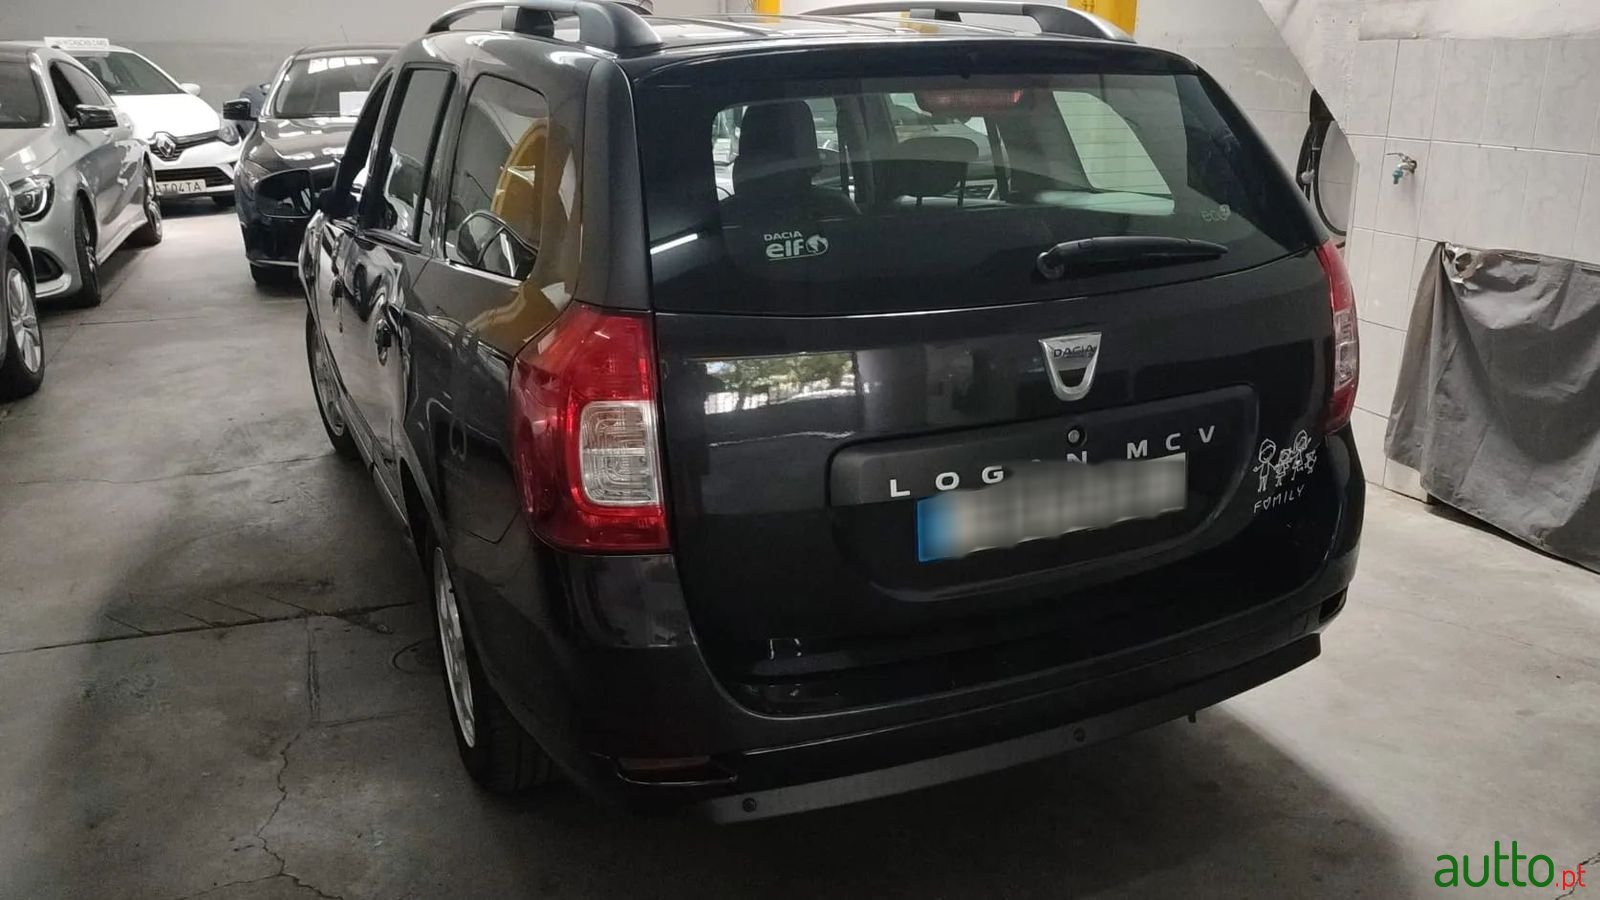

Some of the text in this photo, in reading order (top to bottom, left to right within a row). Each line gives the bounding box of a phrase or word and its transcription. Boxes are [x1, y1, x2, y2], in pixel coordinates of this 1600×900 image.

[764, 231, 803, 241] DACIA
[766, 239, 804, 258] elf
[1053, 344, 1095, 358] DACIA
